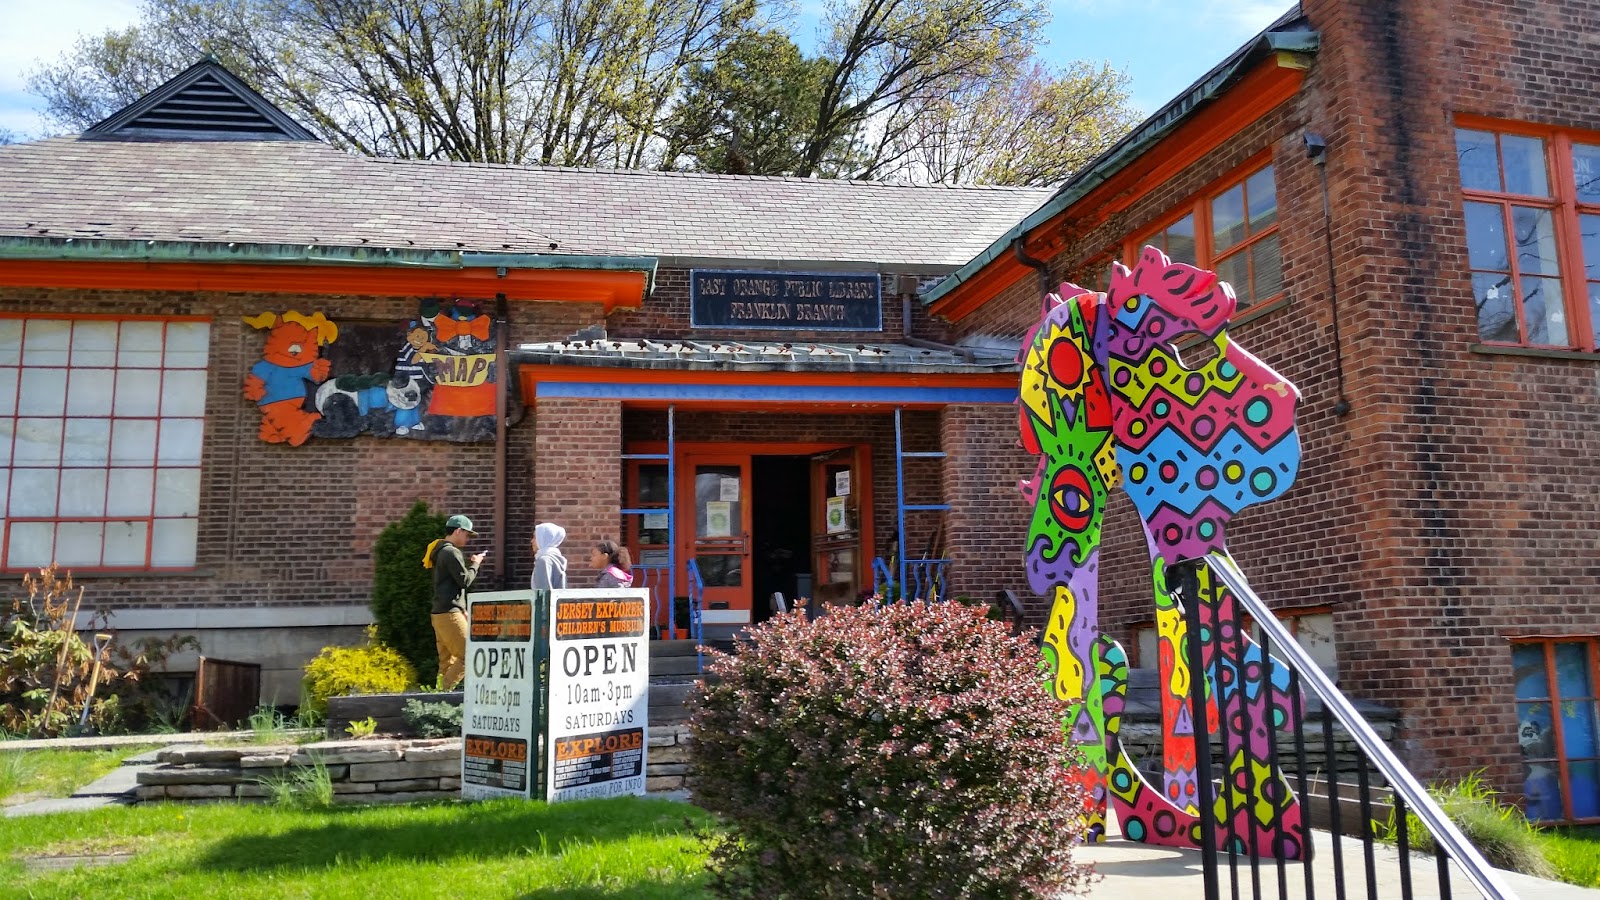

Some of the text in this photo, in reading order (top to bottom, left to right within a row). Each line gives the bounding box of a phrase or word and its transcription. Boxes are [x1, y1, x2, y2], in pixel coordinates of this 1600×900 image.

[700, 278, 874, 299] EAST ORANGE PUBLIC LIBRARY
[731, 302, 845, 320] FRANKLIN BRANCH
[432, 357, 487, 383] MAP
[557, 601, 644, 620] JERSEY EXPLORER
[557, 620, 644, 636] CHILDREN'S MUSEUM
[473, 648, 526, 679] OPEN
[563, 643, 638, 677] OPEN
[475, 684, 520, 712] 10am-3pm
[567, 680, 632, 706] 10am-3pm
[472, 715, 520, 732] SATURDAYS
[565, 710, 634, 730] SATURDAYS
[466, 739, 526, 757] EXPLORE
[556, 732, 642, 757] EXPLORE
[609, 781, 623, 794] FOR
[625, 777, 642, 791] INFO
